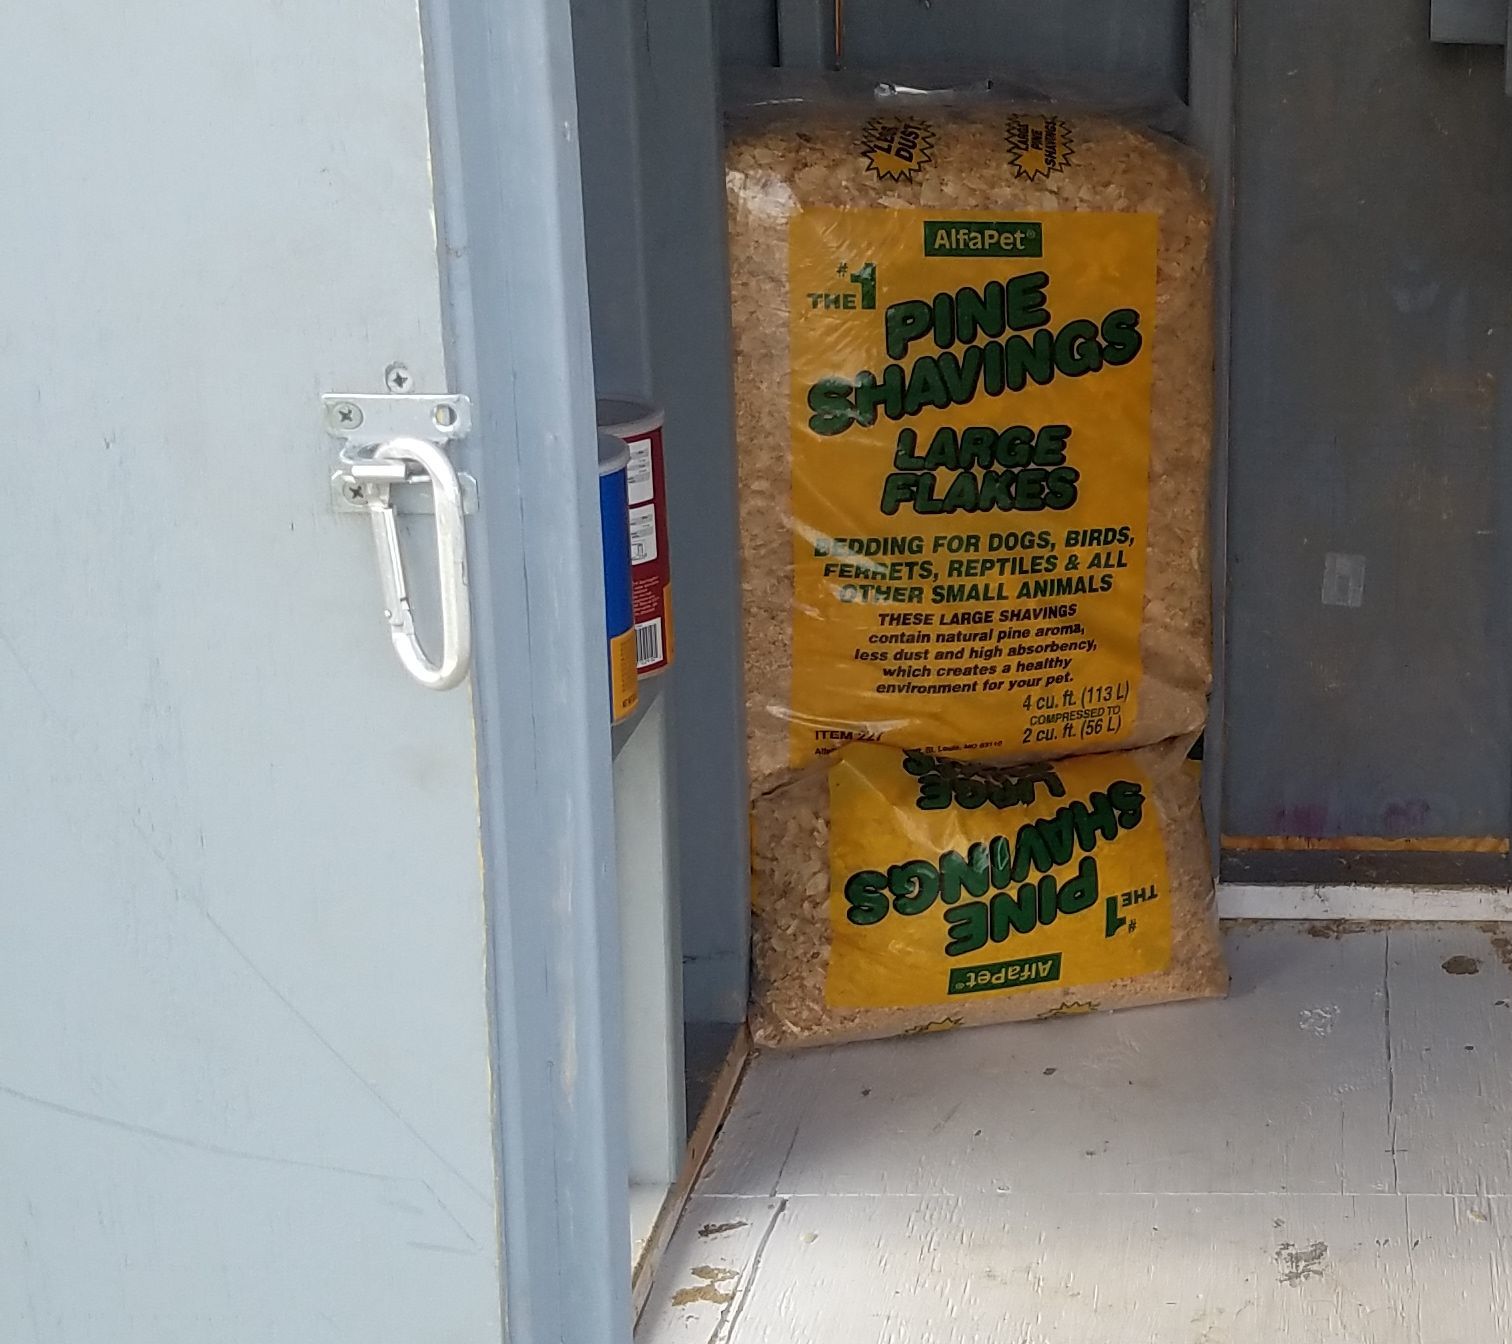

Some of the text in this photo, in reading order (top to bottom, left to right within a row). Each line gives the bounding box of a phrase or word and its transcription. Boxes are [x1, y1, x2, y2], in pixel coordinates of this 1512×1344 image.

[895, 123, 923, 163] DUST
[806, 293, 857, 310] THE
[885, 271, 1050, 360] PINE
[808, 308, 1143, 436] SHAVINGS
[894, 425, 1072, 471] LARGE
[880, 466, 1080, 515] FLAKES
[814, 526, 1135, 558] BEDDING FOR DOGS, BIRDS,
[824, 550, 1128, 582] FERRETS, REPTILES & ALL
[839, 573, 1113, 605] OTHER SMALL ANIMALS
[878, 603, 1078, 627] THESE LARGE SHAVINGS
[868, 623, 1085, 645] contain natural pine aroma,
[854, 637, 1097, 662] less dust and high absorbency,
[882, 655, 1072, 678] which creates a healthy
[876, 672, 1074, 695] environment for your pet.
[1023, 694, 1032, 711] 4
[1036, 695, 1059, 711] cu.
[1081, 686, 1113, 709] (113
[1030, 704, 1121, 726] COMPRESSED TO
[814, 730, 853, 741] ITEM
[1022, 727, 1032, 745] 2
[1036, 728, 1058, 742] cu.
[1080, 719, 1103, 740] (56
[843, 780, 1147, 926] SHAVINGS
[944, 856, 1099, 957] PINE
[1120, 883, 1159, 908] THE
